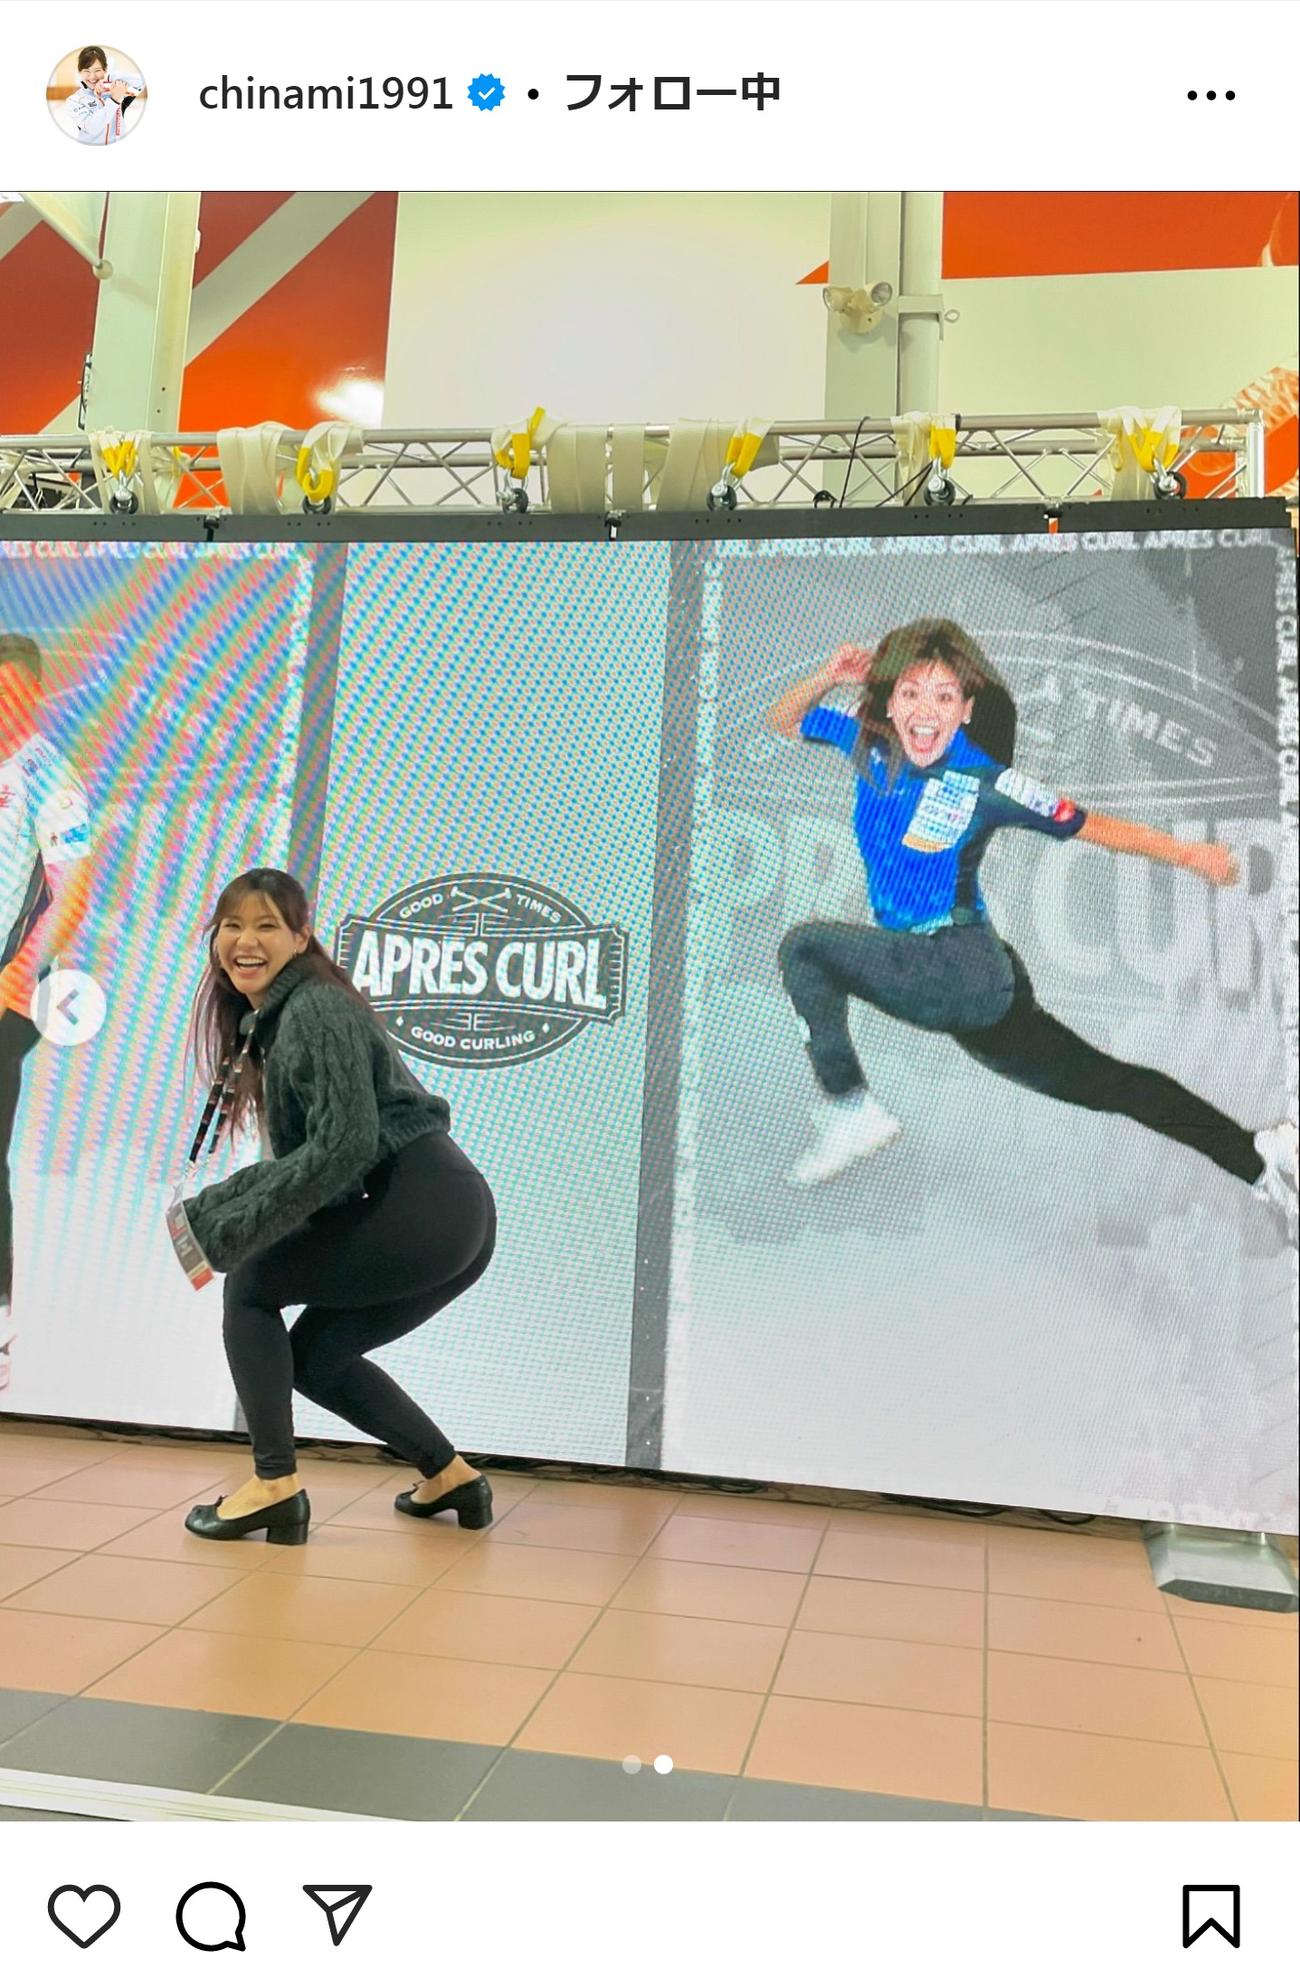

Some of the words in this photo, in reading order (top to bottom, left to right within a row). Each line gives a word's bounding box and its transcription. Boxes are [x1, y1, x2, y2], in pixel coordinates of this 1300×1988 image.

[399, 893, 444, 919] GOOD
[516, 893, 562, 924] TIMES
[496, 937, 607, 1010] CURL
[411, 1026, 456, 1048] GOOD
[460, 1029, 536, 1050] CURLING
